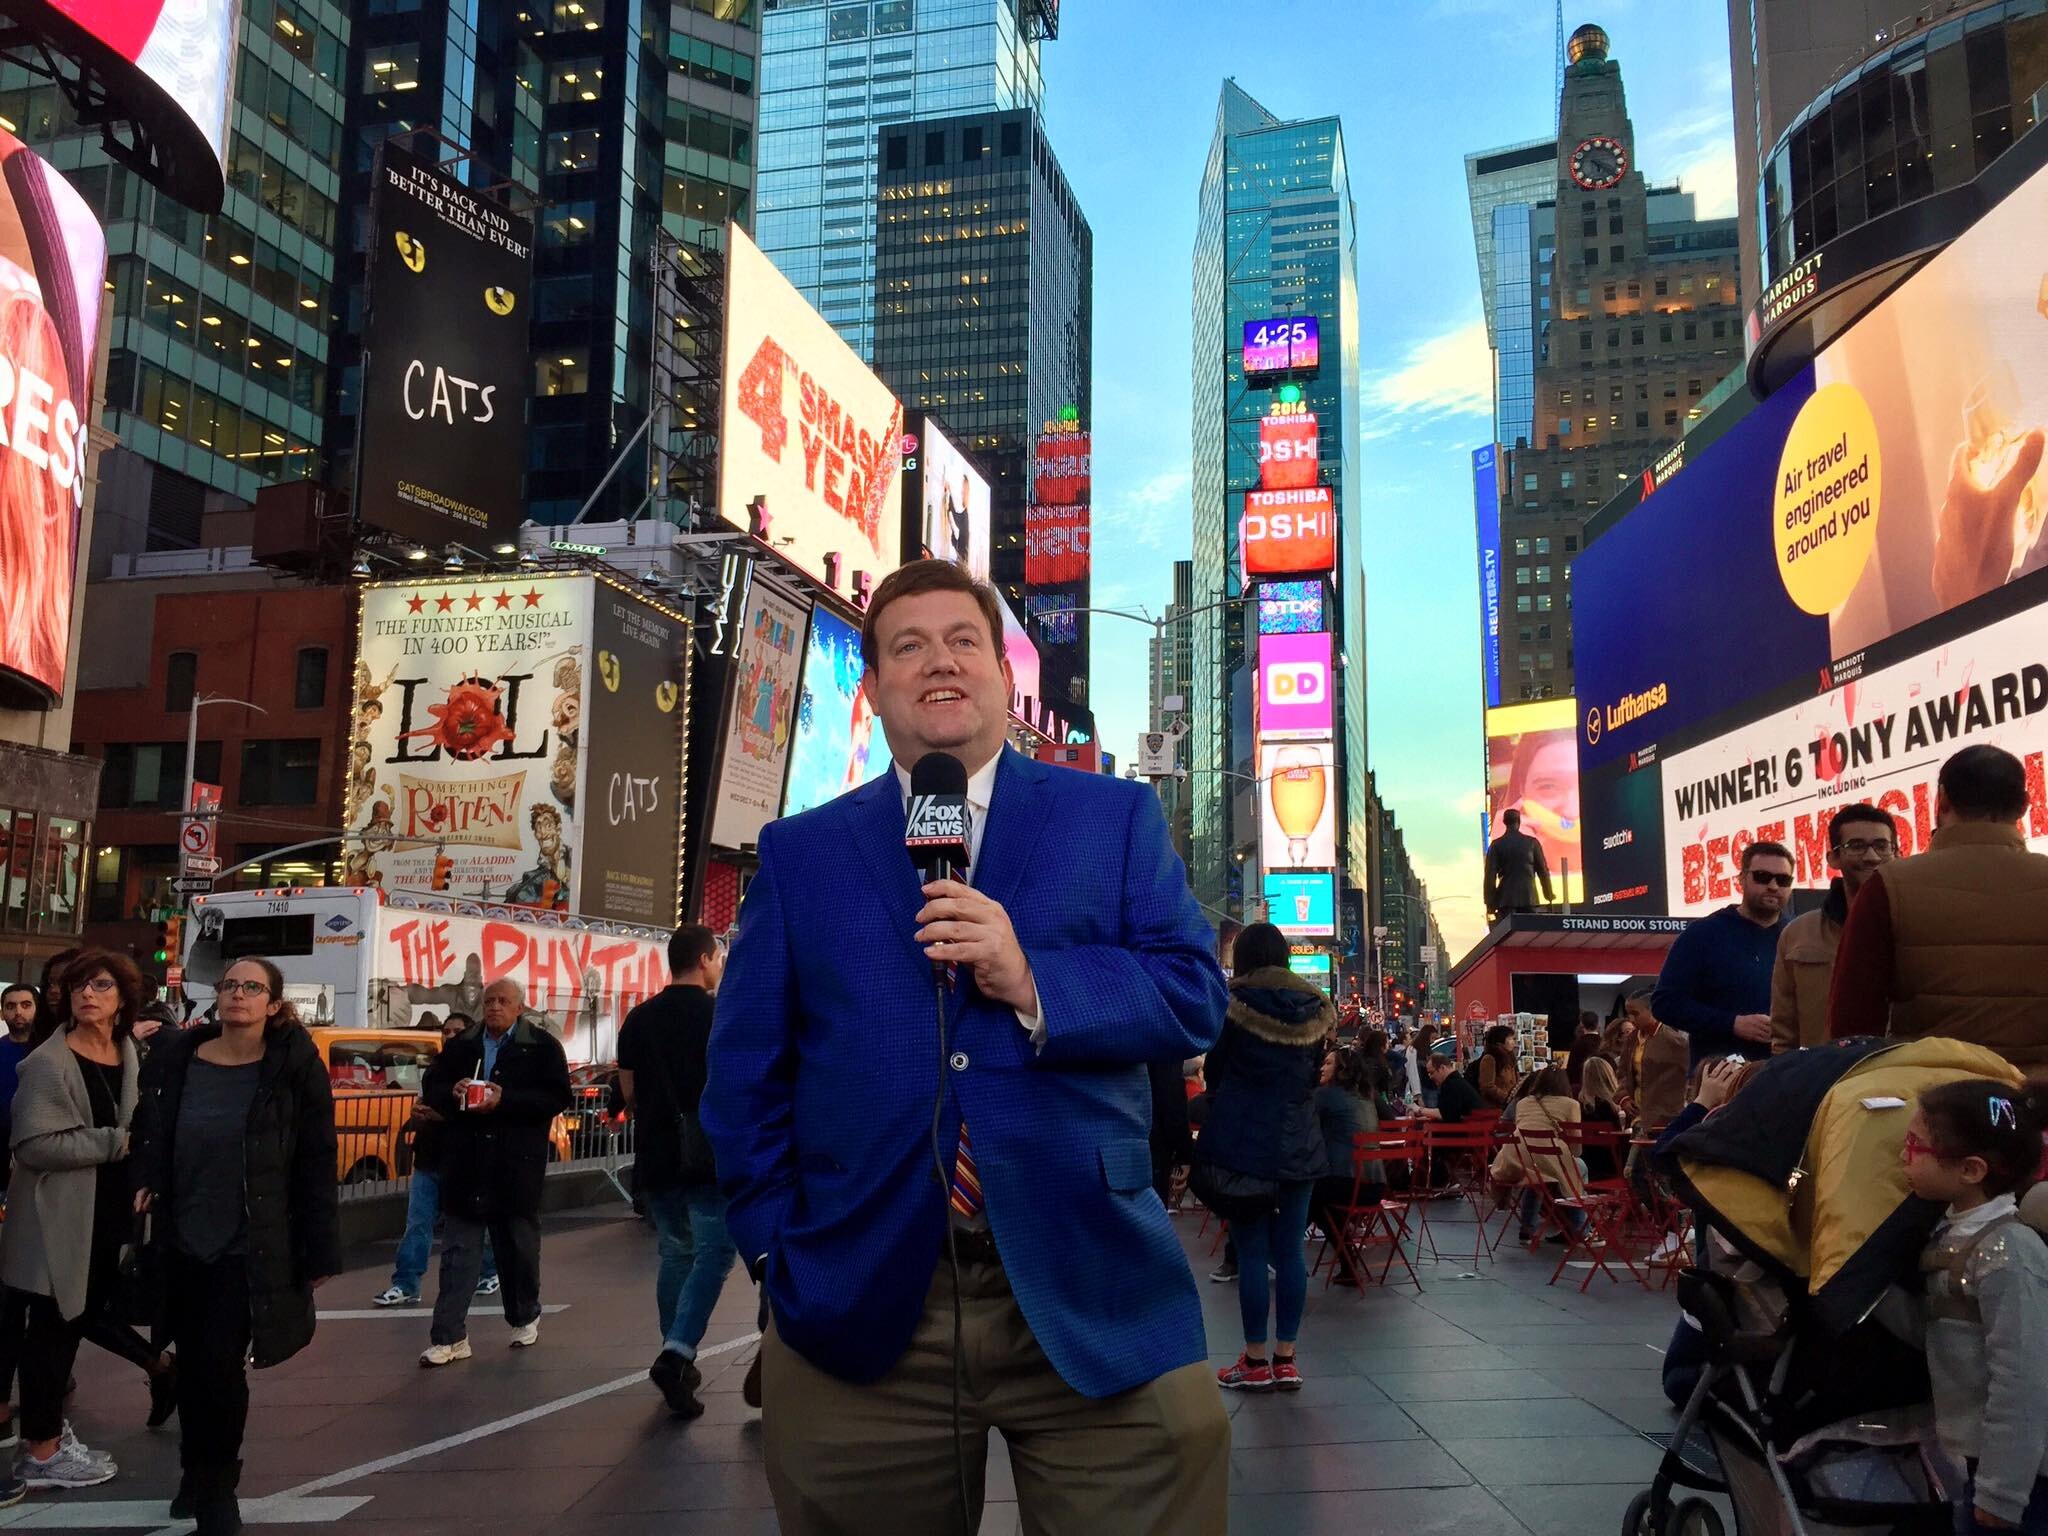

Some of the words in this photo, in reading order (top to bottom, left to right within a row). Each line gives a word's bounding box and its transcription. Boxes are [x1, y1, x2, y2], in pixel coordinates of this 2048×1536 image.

[410, 165, 439, 192] IT'S
[441, 183, 479, 216] BACK
[480, 208, 510, 233] AND
[447, 203, 487, 237] THAN
[1761, 253, 1824, 306] MARRIOTT
[1762, 278, 1816, 328] MARQUIS
[1253, 322, 1308, 348] 4:25
[402, 358, 497, 426] CATS
[1261, 413, 1316, 427] TOSHIBA
[1270, 401, 1307, 416] 2016
[1655, 440, 1686, 474] MARRIOTT
[1784, 468, 1804, 499] Air
[1806, 431, 1848, 483] travel
[1655, 457, 1684, 487] MARQUIS
[398, 480, 489, 522] CATSBROADWAY.COM
[1250, 489, 1329, 506] TOSHIBA
[1785, 453, 1869, 531] engineered
[1786, 510, 1838, 564] around
[1841, 496, 1871, 538] you
[555, 541, 602, 555] LAMAR
[1485, 549, 1499, 637] REUTERS.TV
[375, 619, 408, 636] THE
[412, 616, 494, 634] FUNNIEST
[498, 610, 573, 631] MUSICAL
[402, 637, 426, 656] IN
[430, 636, 469, 655] 400
[1833, 651, 1866, 673] MARRIOTT
[1833, 664, 1863, 684] MARQUIS
[1274, 671, 1319, 697] DD
[1606, 682, 1668, 733] Lufthansa
[1674, 754, 1779, 822] WINNER!
[1784, 747, 1803, 789] 6
[1808, 713, 1897, 780] TONY
[1904, 662, 2048, 754] AWARD
[416, 779, 508, 793] SOMETHING
[608, 771, 660, 827] CATS
[1817, 776, 1867, 799] INCLUDING
[925, 804, 963, 821] FOX
[905, 837, 963, 846] channel
[913, 820, 964, 837] NEWS
[1602, 831, 1627, 850] swatch
[469, 855, 517, 866] ALADDIN
[394, 874, 416, 885] THE
[452, 873, 465, 884] OF
[467, 873, 514, 885] MORMON
[267, 902, 290, 914] 71410
[1562, 918, 1610, 930] STRAND
[1612, 919, 1647, 930] BOOK
[1649, 919, 1688, 931] STORE
[389, 919, 457, 989] THE
[1291, 945, 1315, 955] ISSUES
